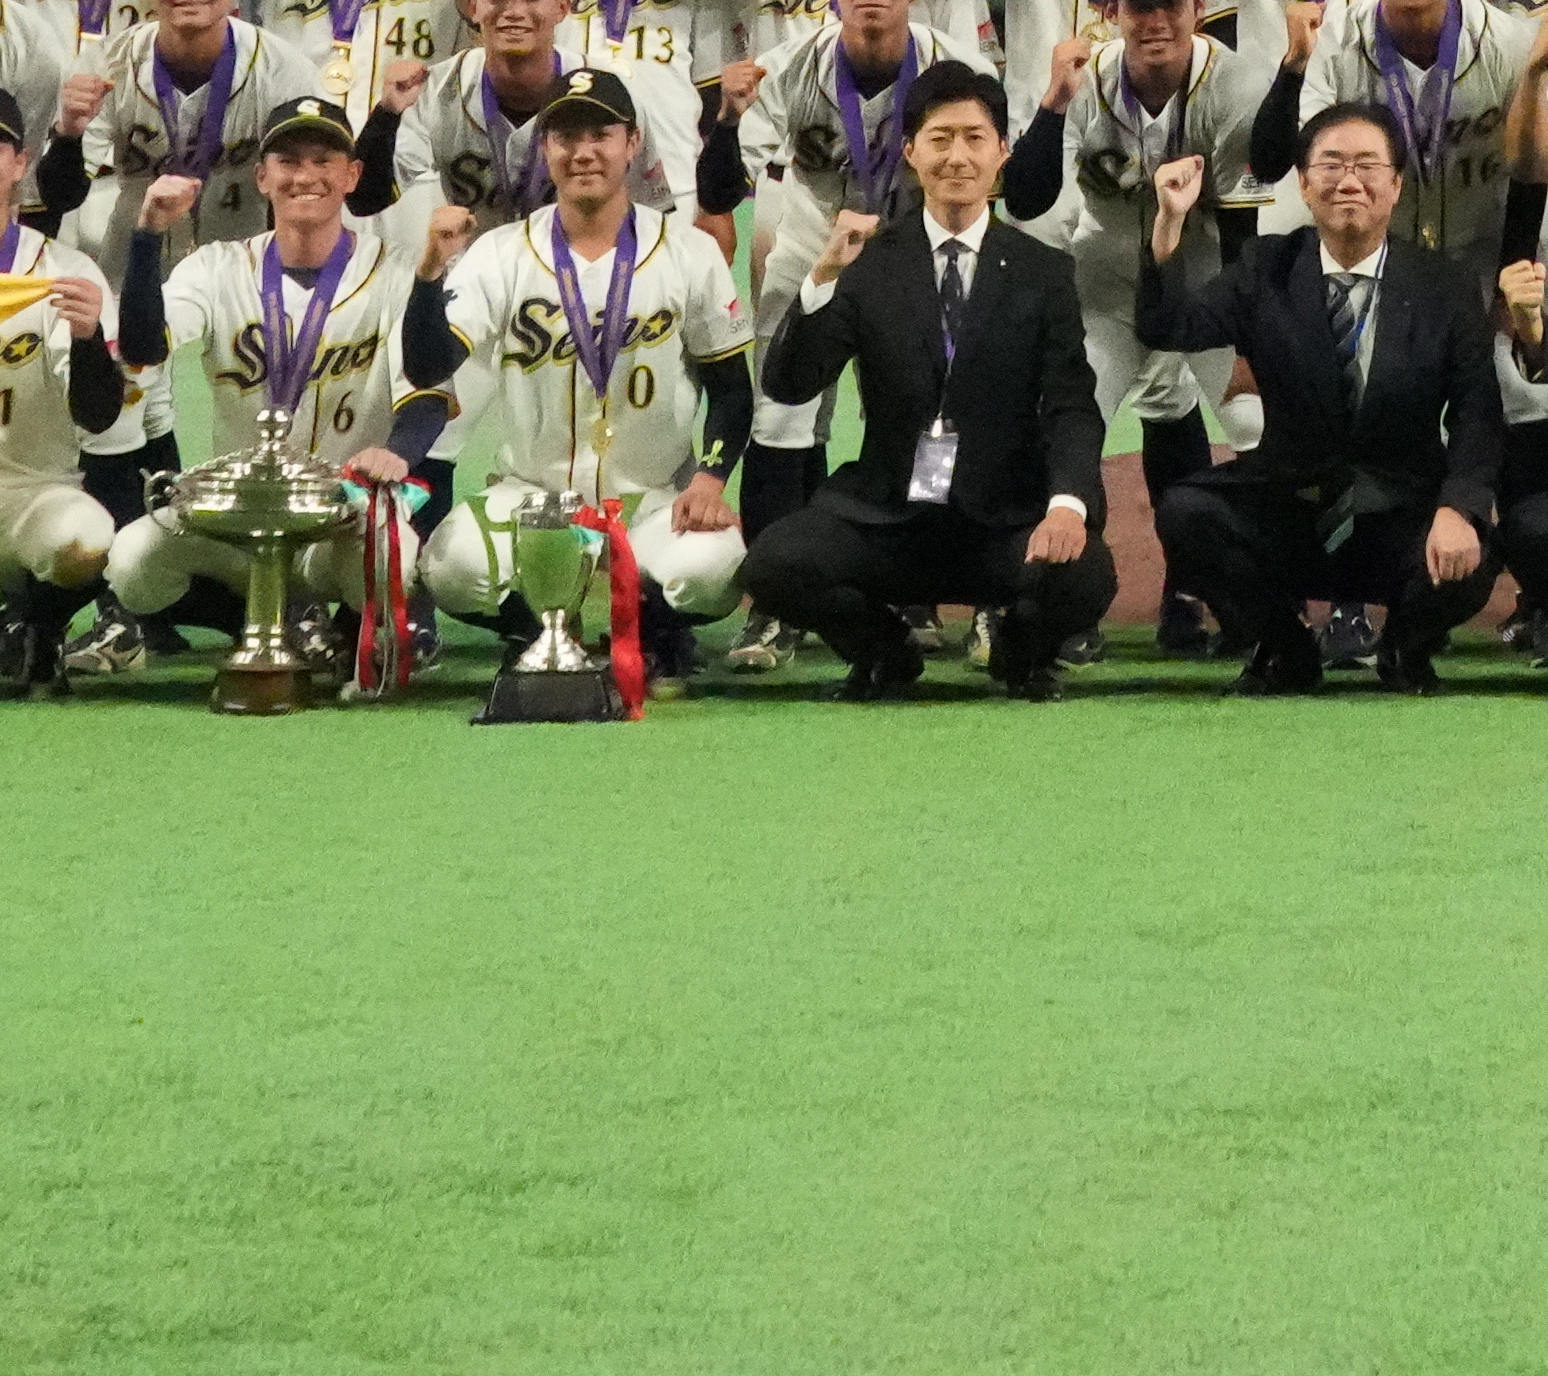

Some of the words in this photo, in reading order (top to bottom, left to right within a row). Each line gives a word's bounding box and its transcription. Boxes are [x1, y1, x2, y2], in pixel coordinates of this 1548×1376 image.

[385, 17, 435, 59] 48
[629, 26, 675, 64] 13
[628, 364, 654, 409] 0
